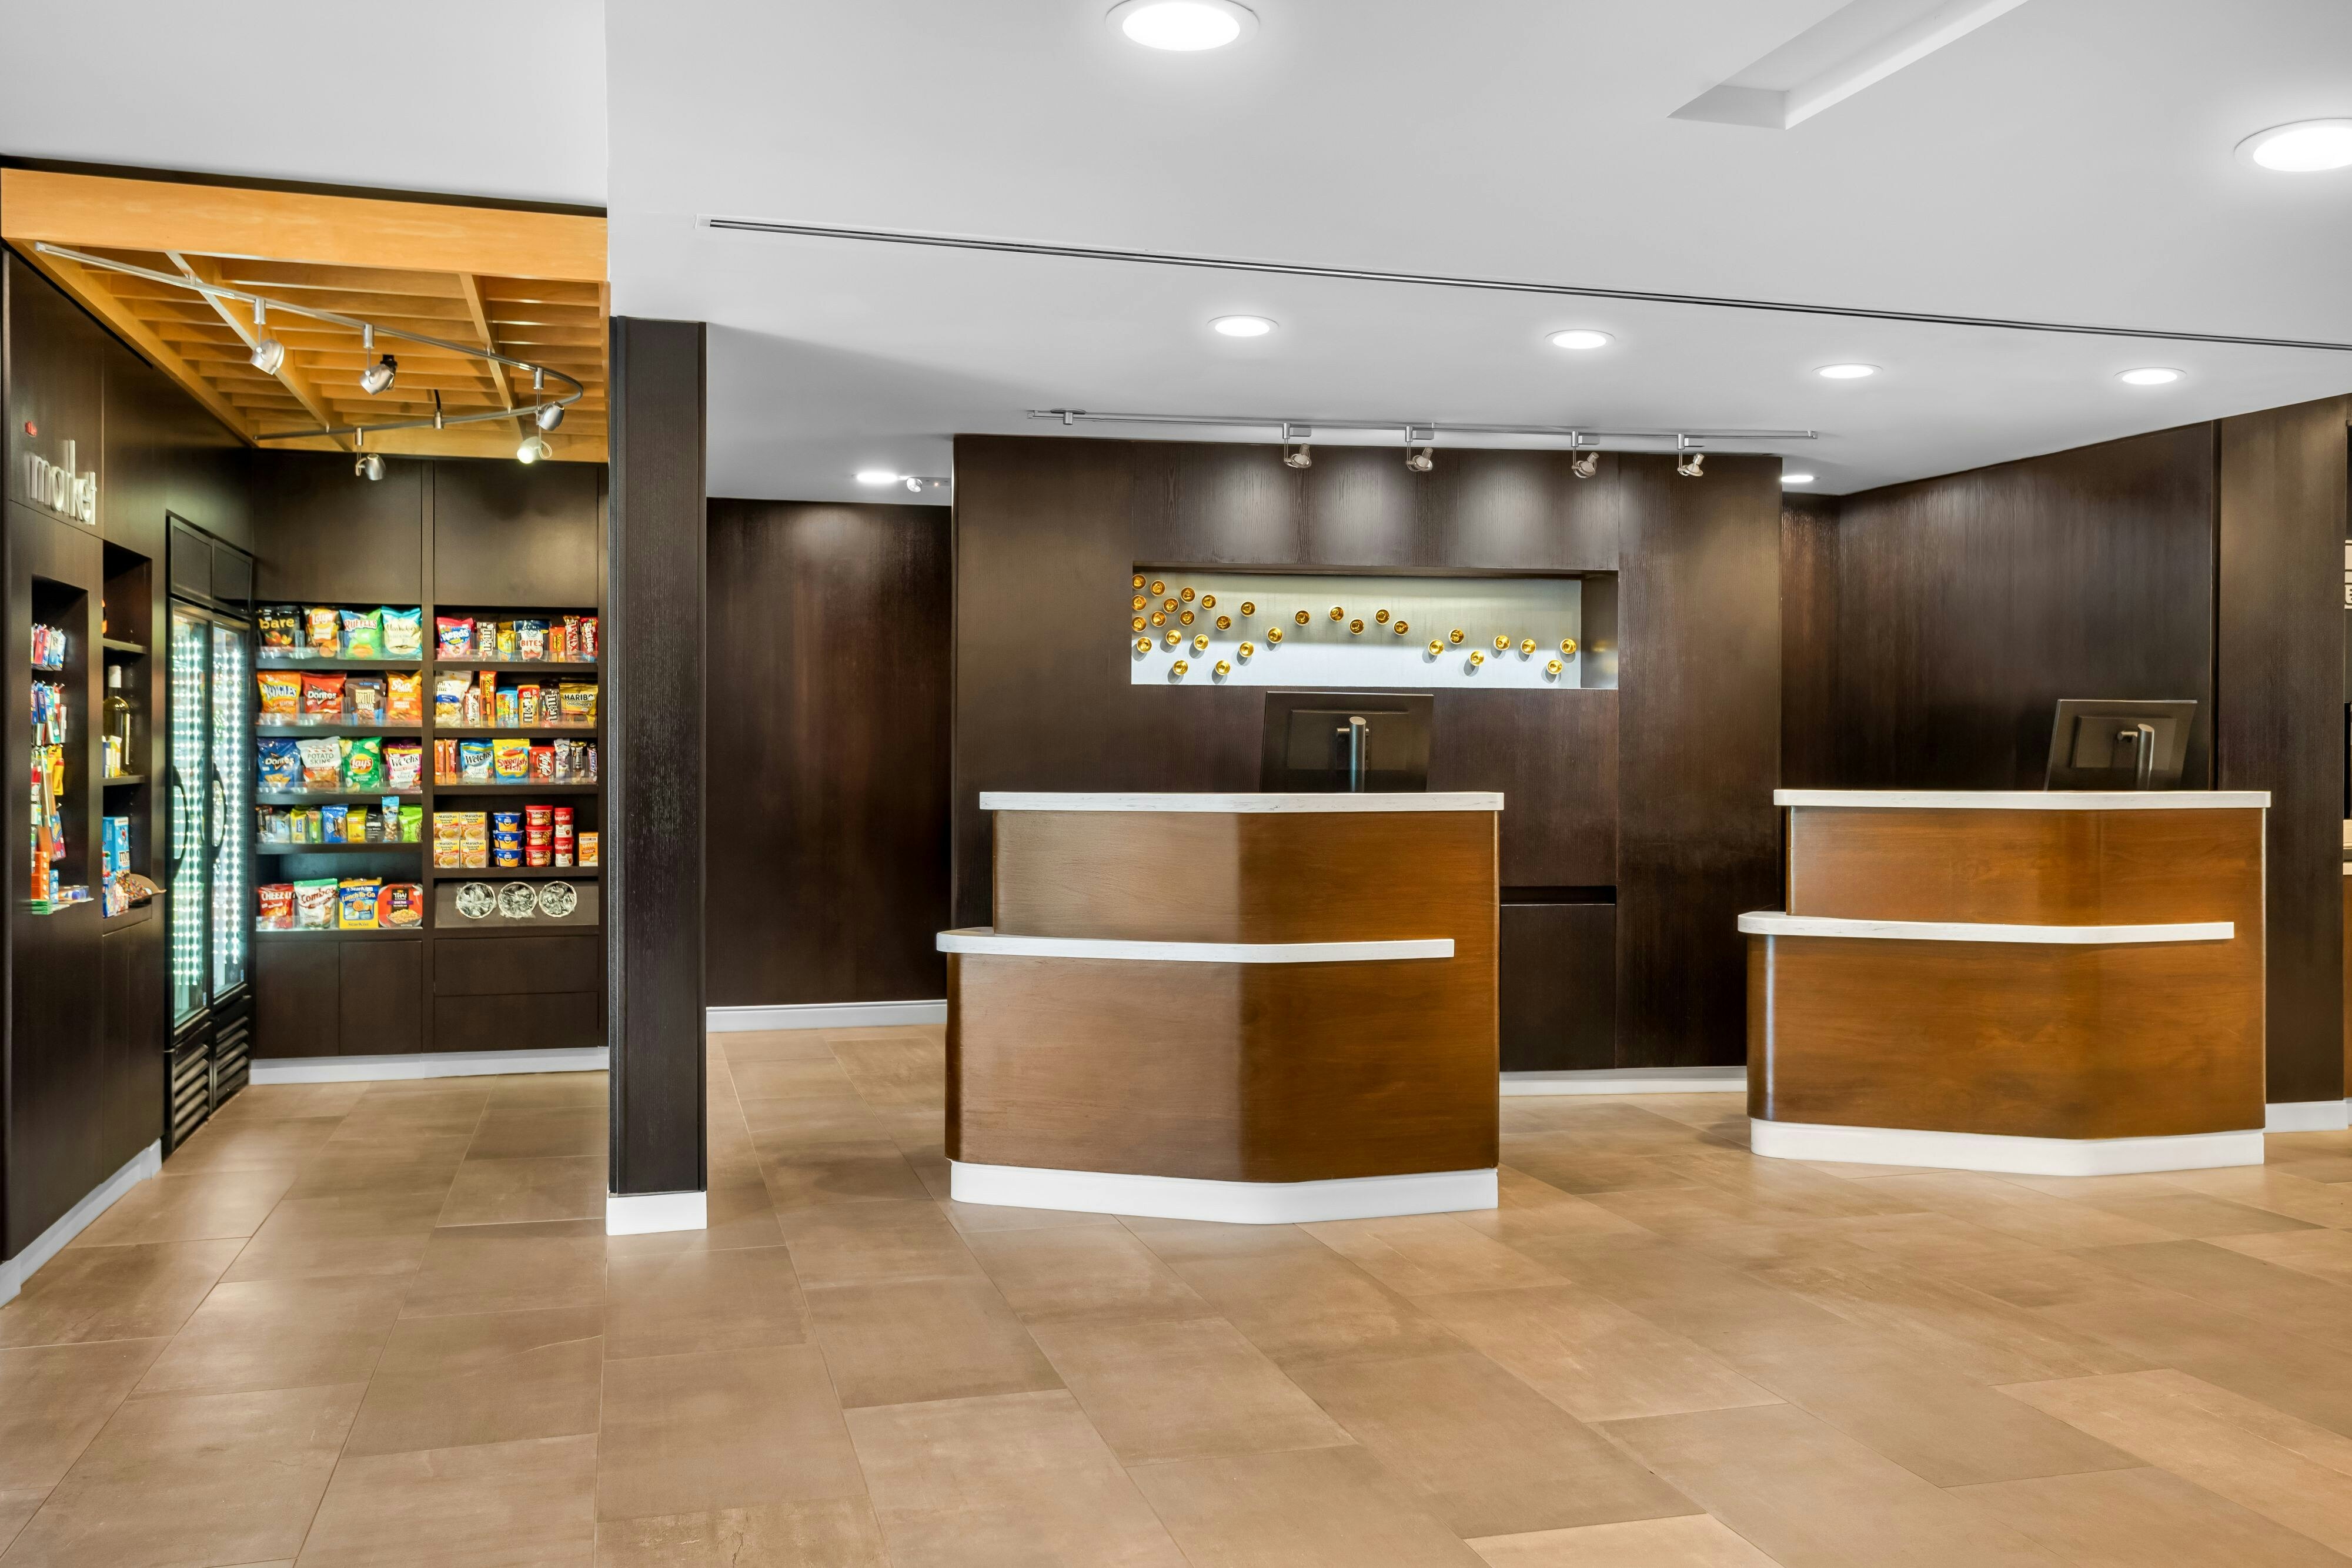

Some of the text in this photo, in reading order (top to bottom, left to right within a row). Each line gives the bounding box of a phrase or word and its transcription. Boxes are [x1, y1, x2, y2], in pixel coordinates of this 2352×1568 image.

[30, 439, 96, 526] market
[259, 618, 295, 629] bare
[345, 619, 377, 631] RUFFLES
[568, 620, 579, 652] TWIX
[584, 622, 594, 653] Skittles
[263, 684, 296, 700] BUGLES
[307, 690, 337, 699] Doritos
[265, 757, 295, 765] Doritos
[351, 758, 372, 770] Lay's
[465, 752, 492, 764] Welch's
[497, 756, 527, 767] Swedish
[301, 887, 336, 904] Combos
[342, 892, 359, 901] Lunch
